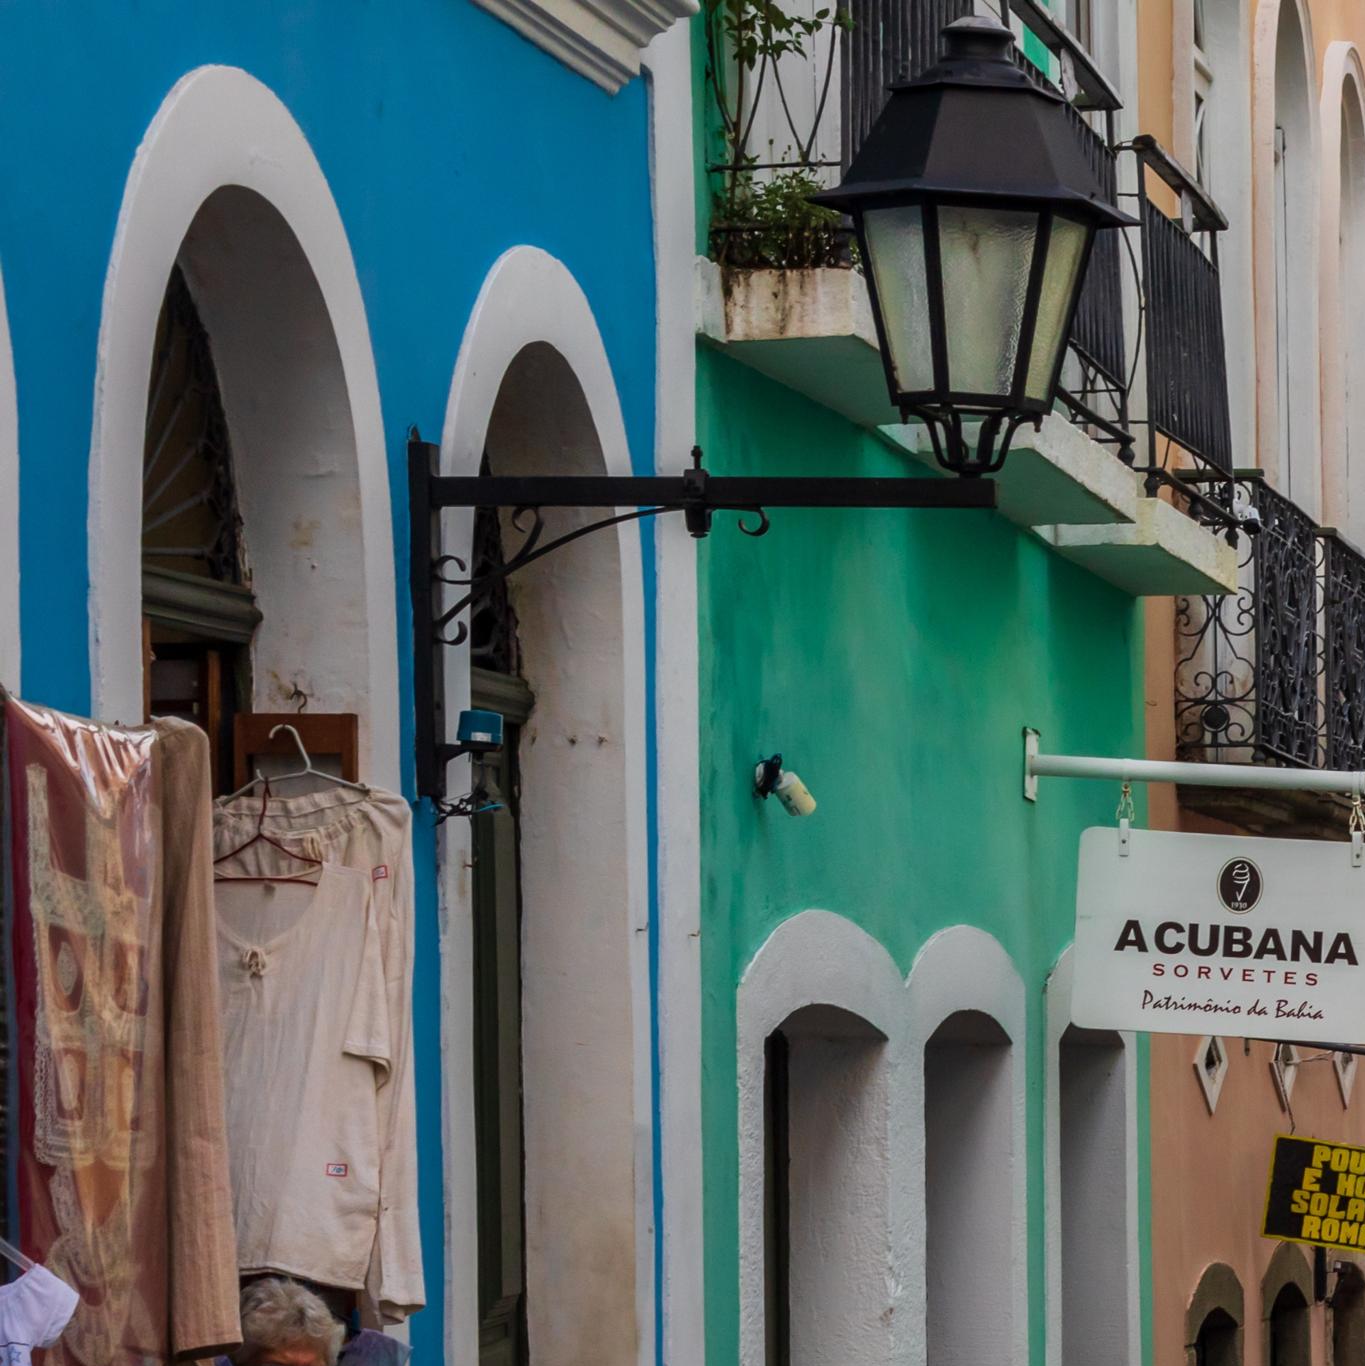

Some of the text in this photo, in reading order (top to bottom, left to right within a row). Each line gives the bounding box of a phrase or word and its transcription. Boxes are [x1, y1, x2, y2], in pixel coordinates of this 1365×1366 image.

[1153, 963, 1318, 986] SORVETES
[1141, 990, 1323, 1020] Patrimônio da Bahia
[1302, 1168, 1322, 1191] E
